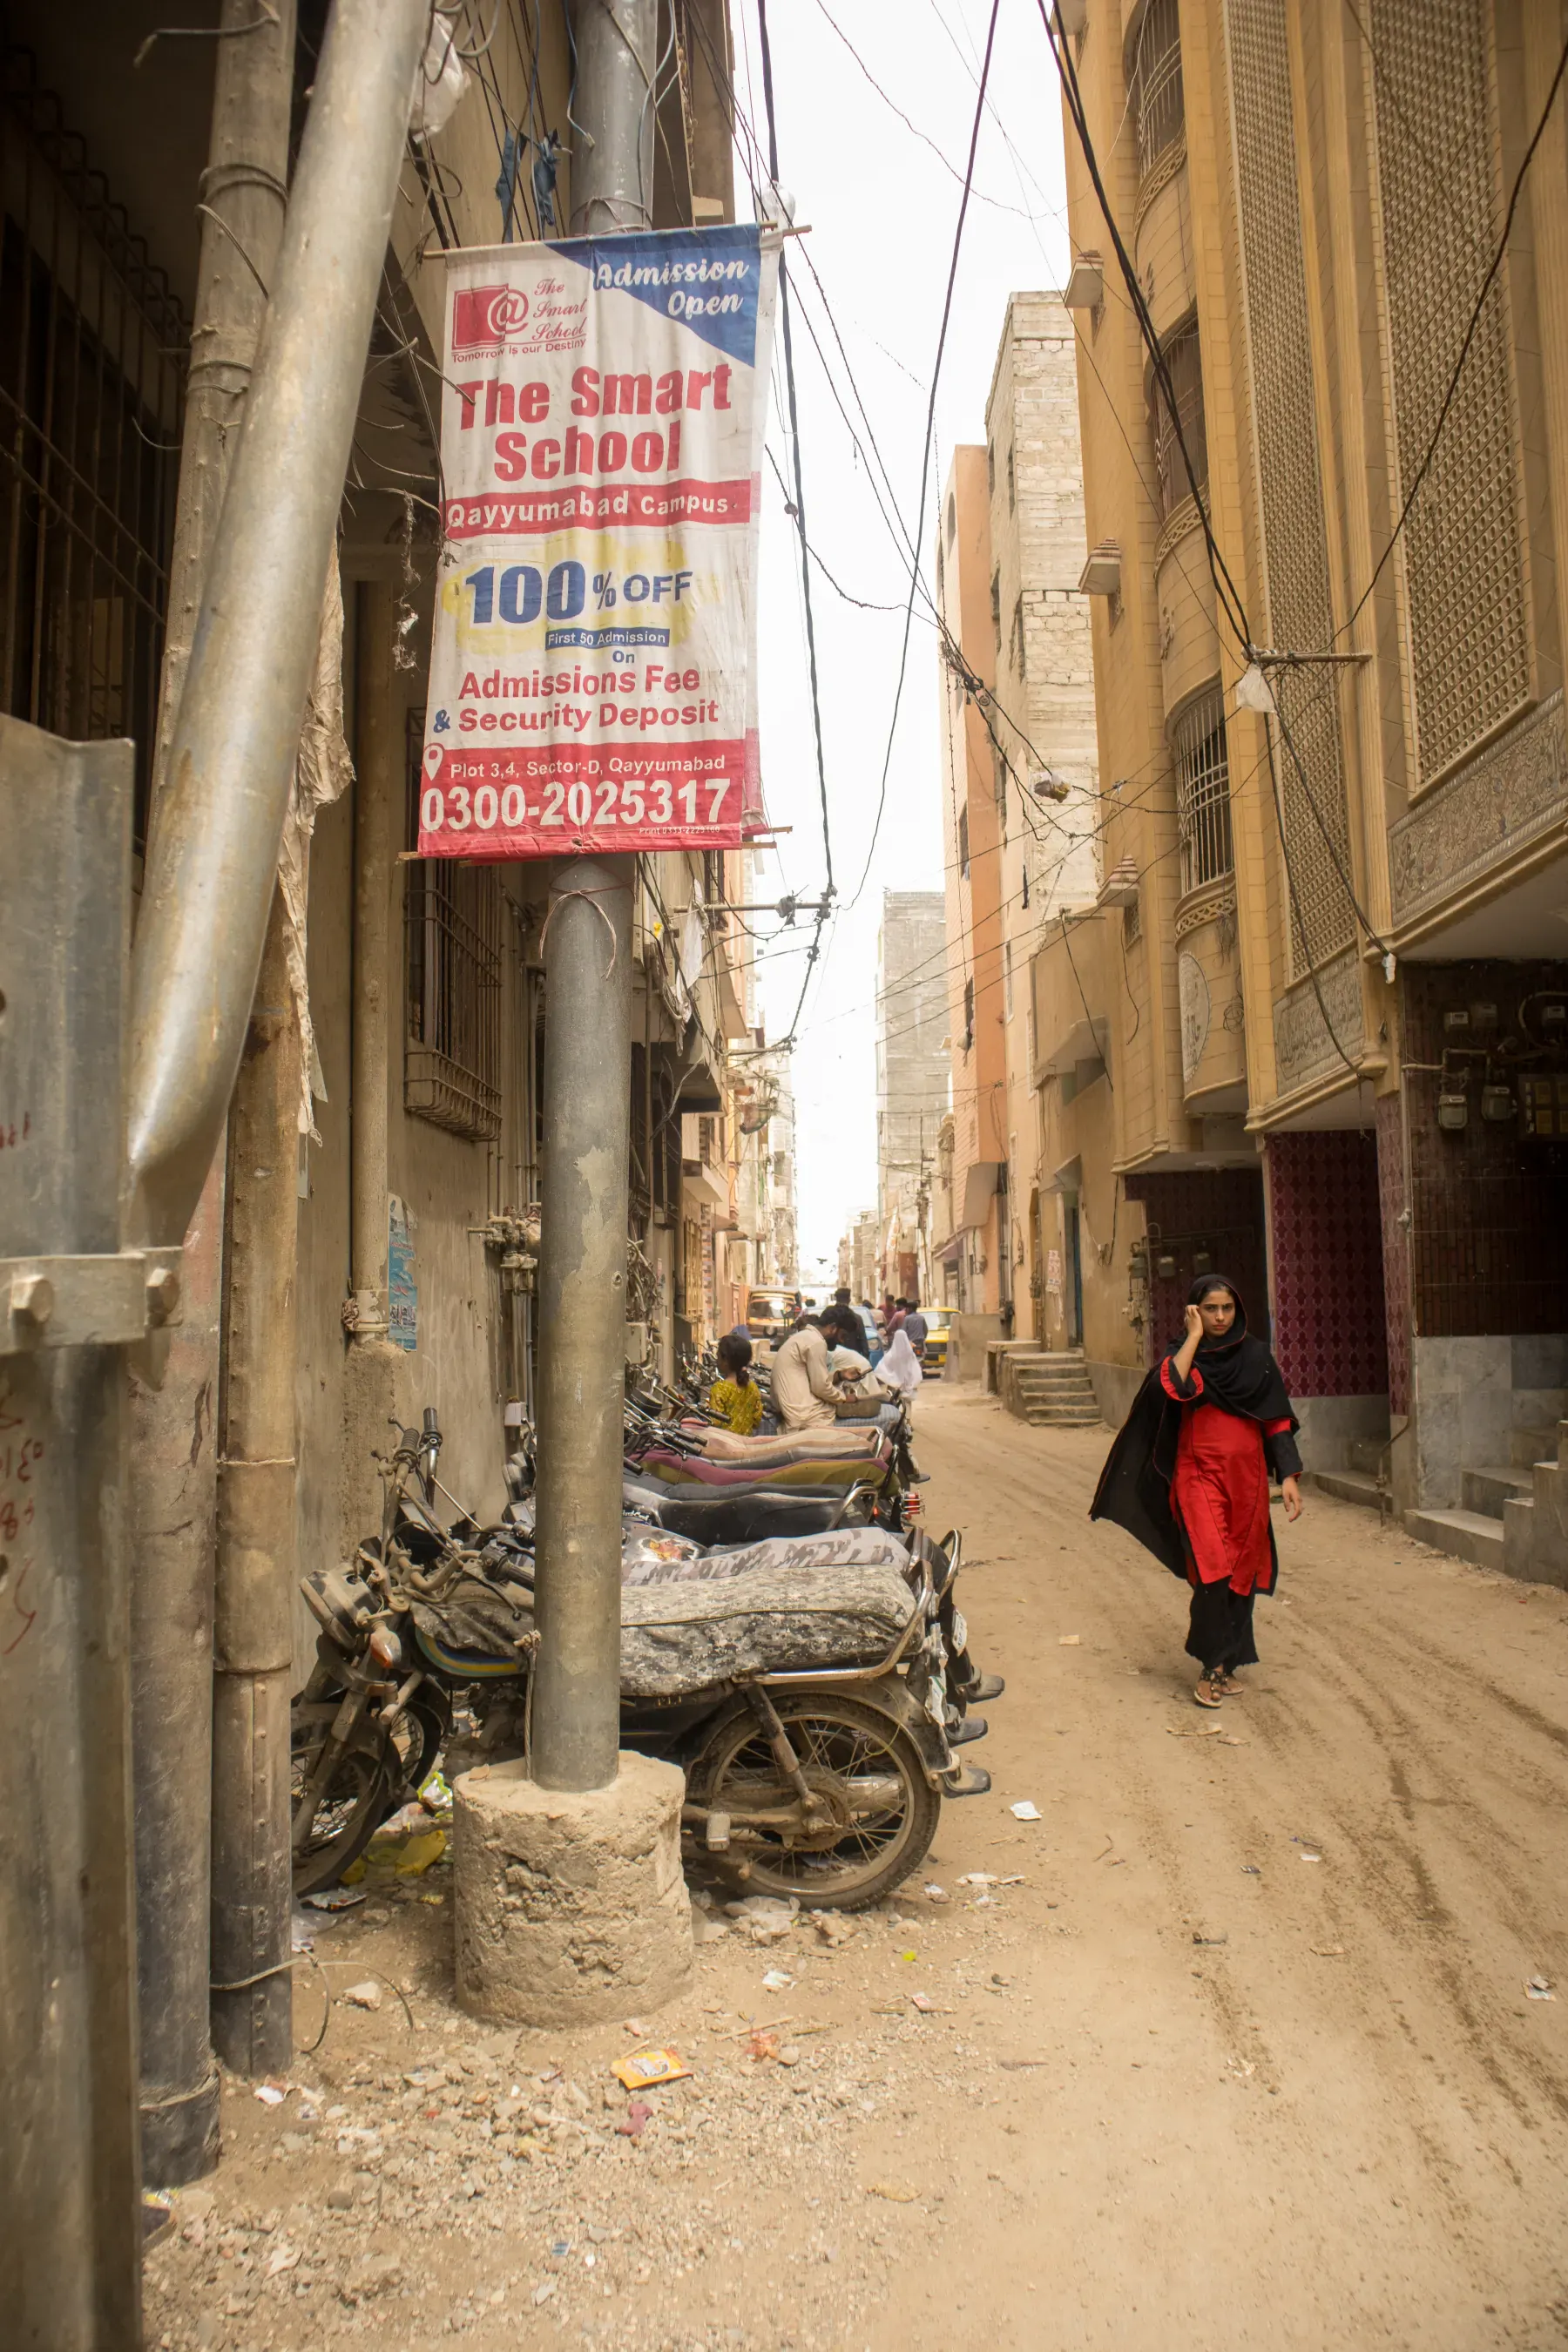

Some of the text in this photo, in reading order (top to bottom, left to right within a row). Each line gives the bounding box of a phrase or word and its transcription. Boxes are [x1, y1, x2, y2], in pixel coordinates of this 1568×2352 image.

[534, 278, 564, 296] The
[596, 258, 749, 289] Admission
[533, 299, 588, 318] Smart
[668, 290, 744, 319] Open
[531, 317, 587, 341] School
[452, 338, 586, 363] Tomorrow is our Destiny
[455, 363, 733, 430] The Smart
[493, 420, 681, 482] School
[447, 490, 729, 529] Qayyumabad Campus
[623, 571, 693, 603] OFF
[548, 631, 665, 645] First 50 Admission
[612, 650, 635, 664] On
[458, 665, 700, 700] Admissions Fee
[433, 699, 719, 733] & Security Deposit
[450, 763, 484, 779] Plot
[527, 760, 603, 776] Sector-D,
[609, 754, 725, 776] Qayyumabad
[422, 778, 730, 830] 0300-2025317
